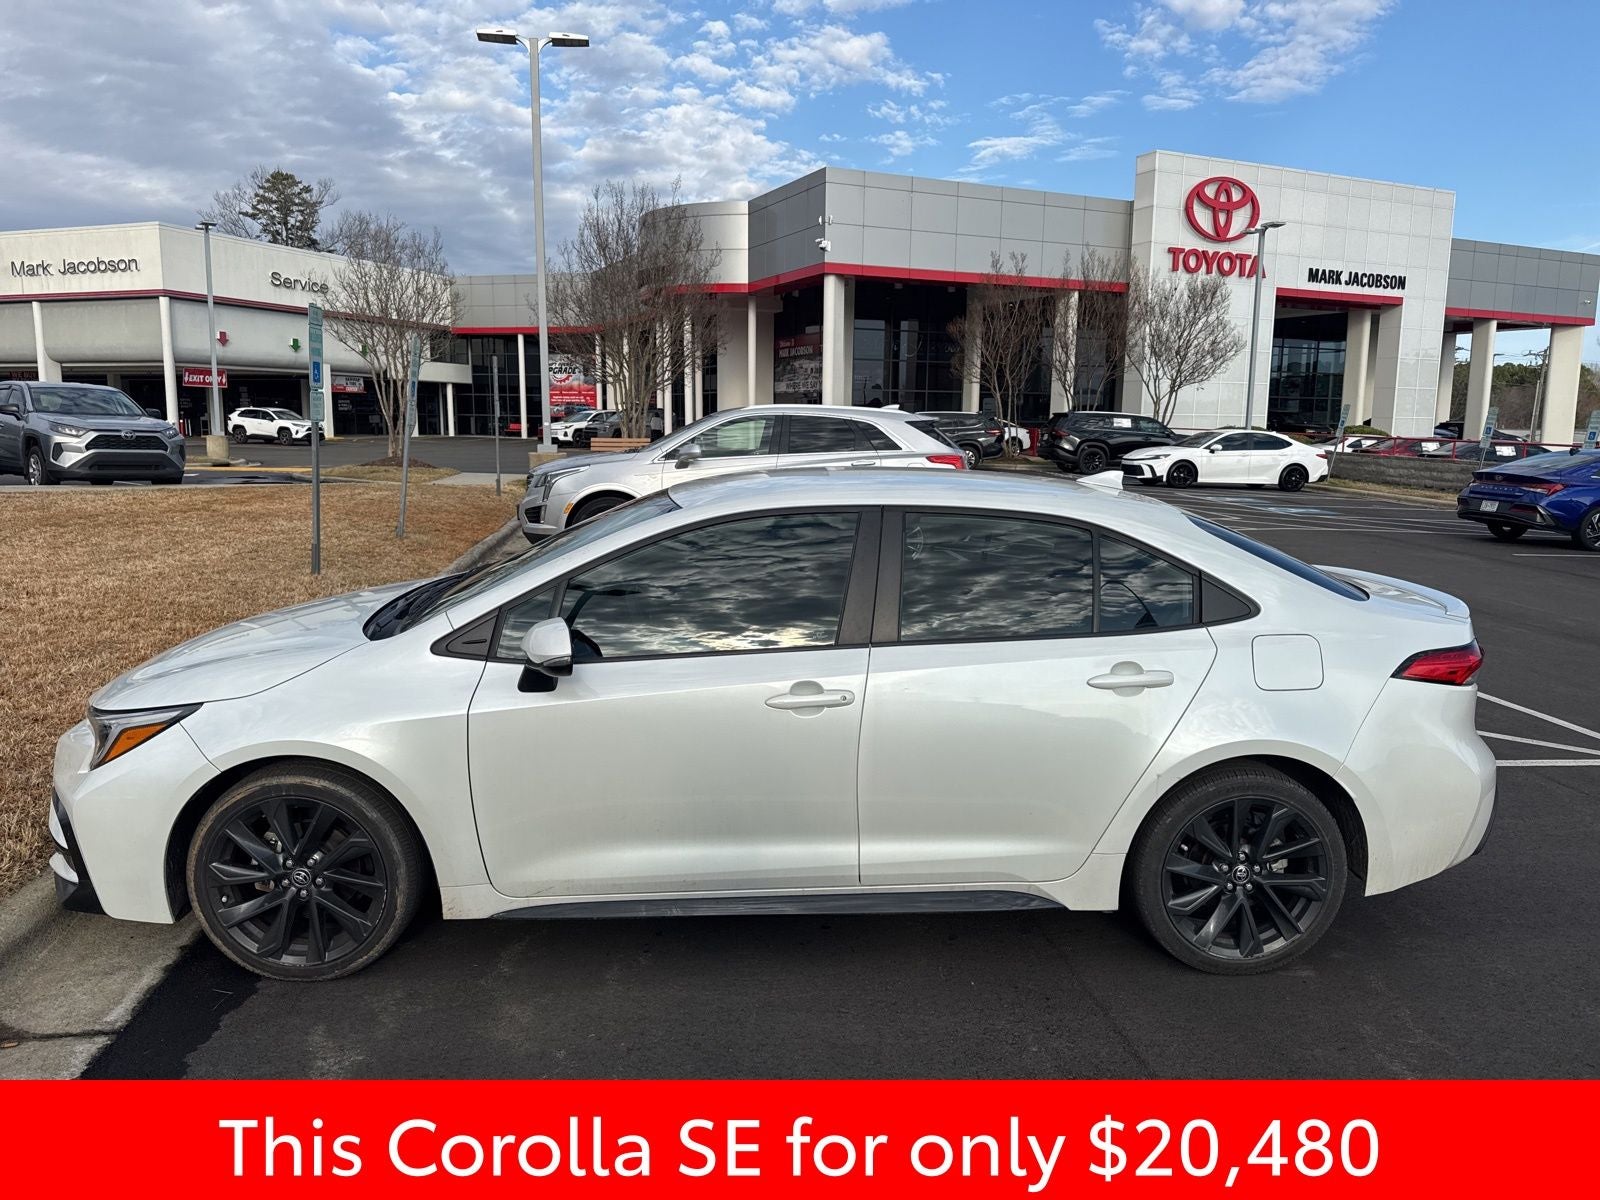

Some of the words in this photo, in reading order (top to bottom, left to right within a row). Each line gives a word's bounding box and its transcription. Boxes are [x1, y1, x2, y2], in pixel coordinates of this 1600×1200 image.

[10, 260, 54, 277] Mark
[58, 257, 140, 276] Jacobson
[271, 271, 329, 294] Service
[1308, 268, 1343, 285] MARK
[1344, 271, 1407, 290] JACOBSON
[189, 374, 204, 383] EXIT
[548, 366, 578, 375] PGRADE
